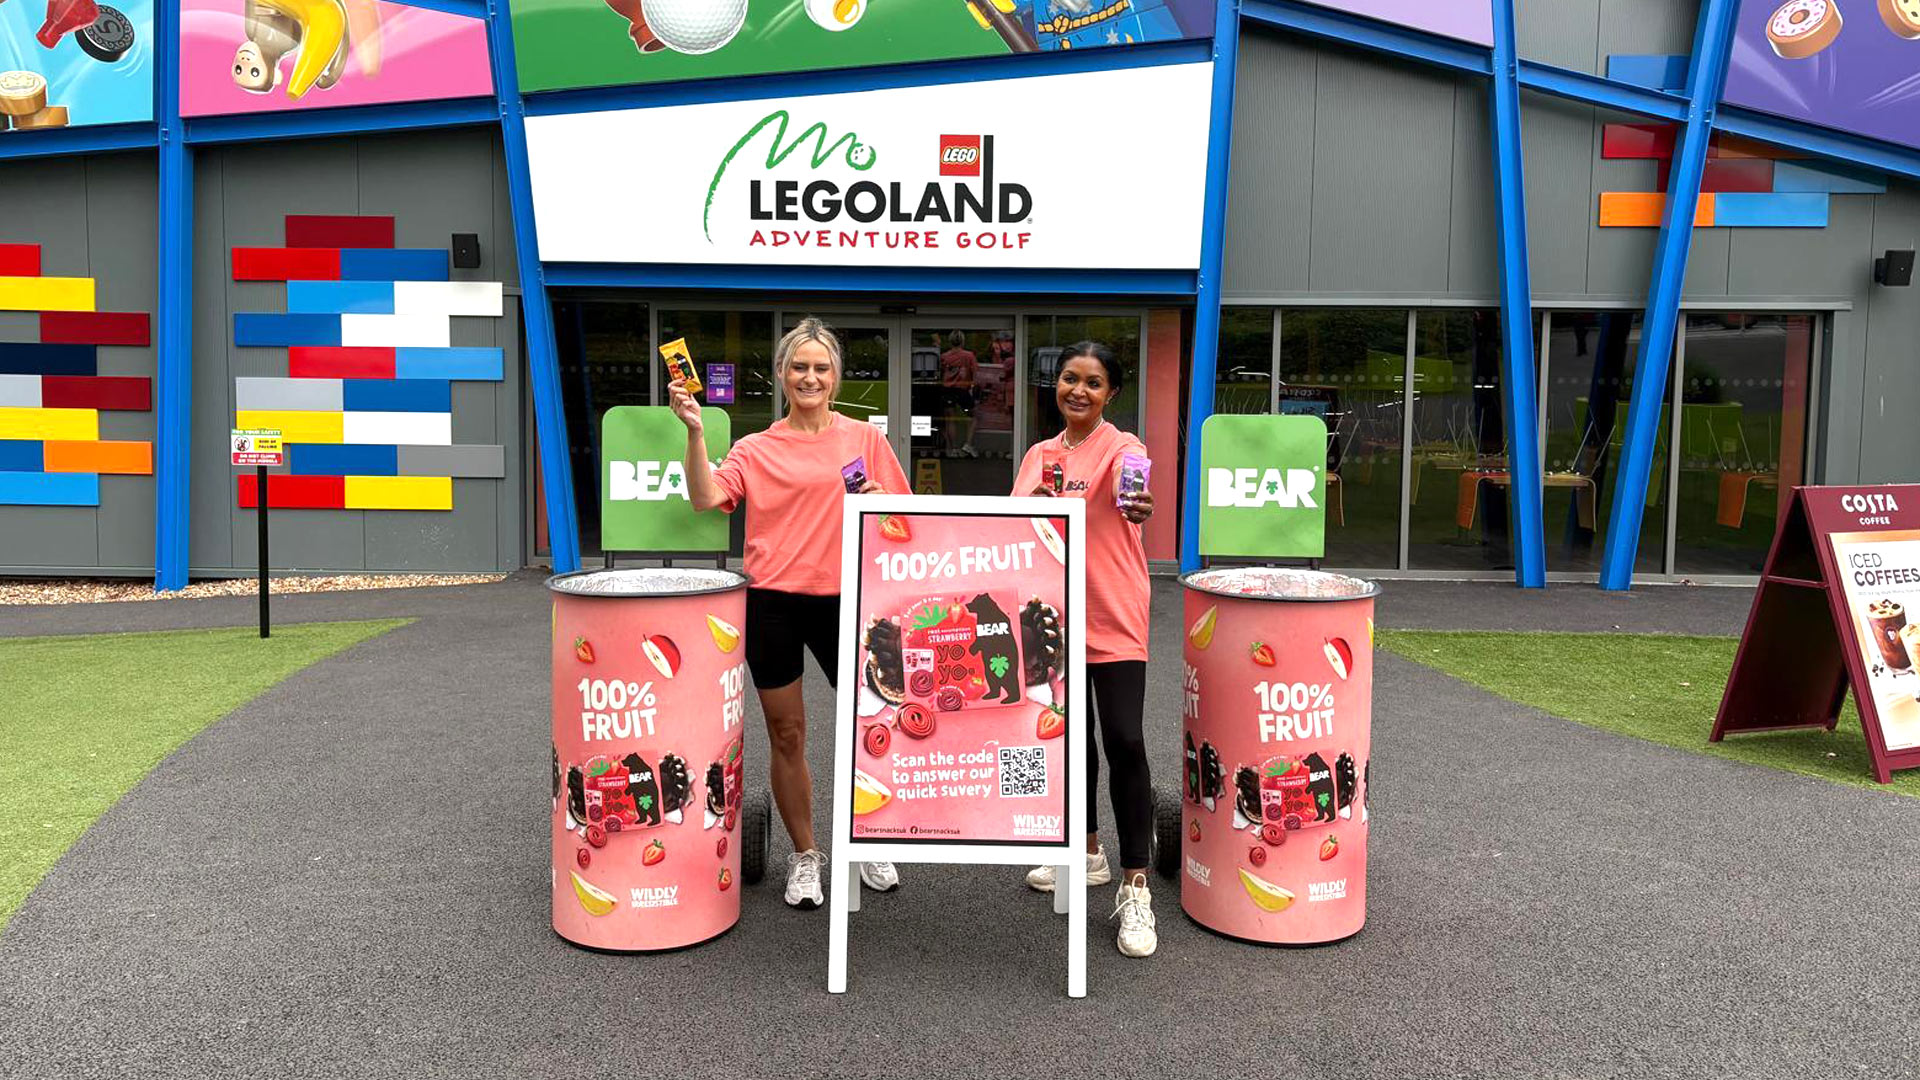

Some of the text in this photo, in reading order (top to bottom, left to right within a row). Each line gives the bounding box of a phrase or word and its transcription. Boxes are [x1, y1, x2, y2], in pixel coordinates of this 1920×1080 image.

[942, 147, 978, 164] LEGO
[750, 135, 1033, 223] LEGOLAND
[749, 230, 1032, 249] ADVENTURE GOLF
[609, 460, 718, 501] BEA
[1208, 467, 1318, 508] BEAR
[1841, 494, 1899, 514] COSTA
[1859, 516, 1891, 525] COFFEE
[874, 541, 1036, 581] 100% FRUIT
[1848, 553, 1883, 568] ICED
[1854, 568, 1920, 587] COFFEES
[928, 632, 971, 643] STRAWBERRY
[976, 622, 1009, 637] BEAR
[577, 678, 656, 711] 100%
[1253, 681, 1334, 713] 100%
[581, 708, 657, 742] FRUIT
[1258, 709, 1335, 743] FRUIT
[892, 749, 994, 768] Scan the code
[629, 771, 652, 783] BEAR
[892, 766, 995, 784] to answer our
[1309, 770, 1330, 782] BEAR
[896, 783, 992, 802] quick suvery
[1013, 814, 1061, 829] WILDLY
[631, 885, 678, 900] WILDLY
[1308, 878, 1346, 895] WILDLY
